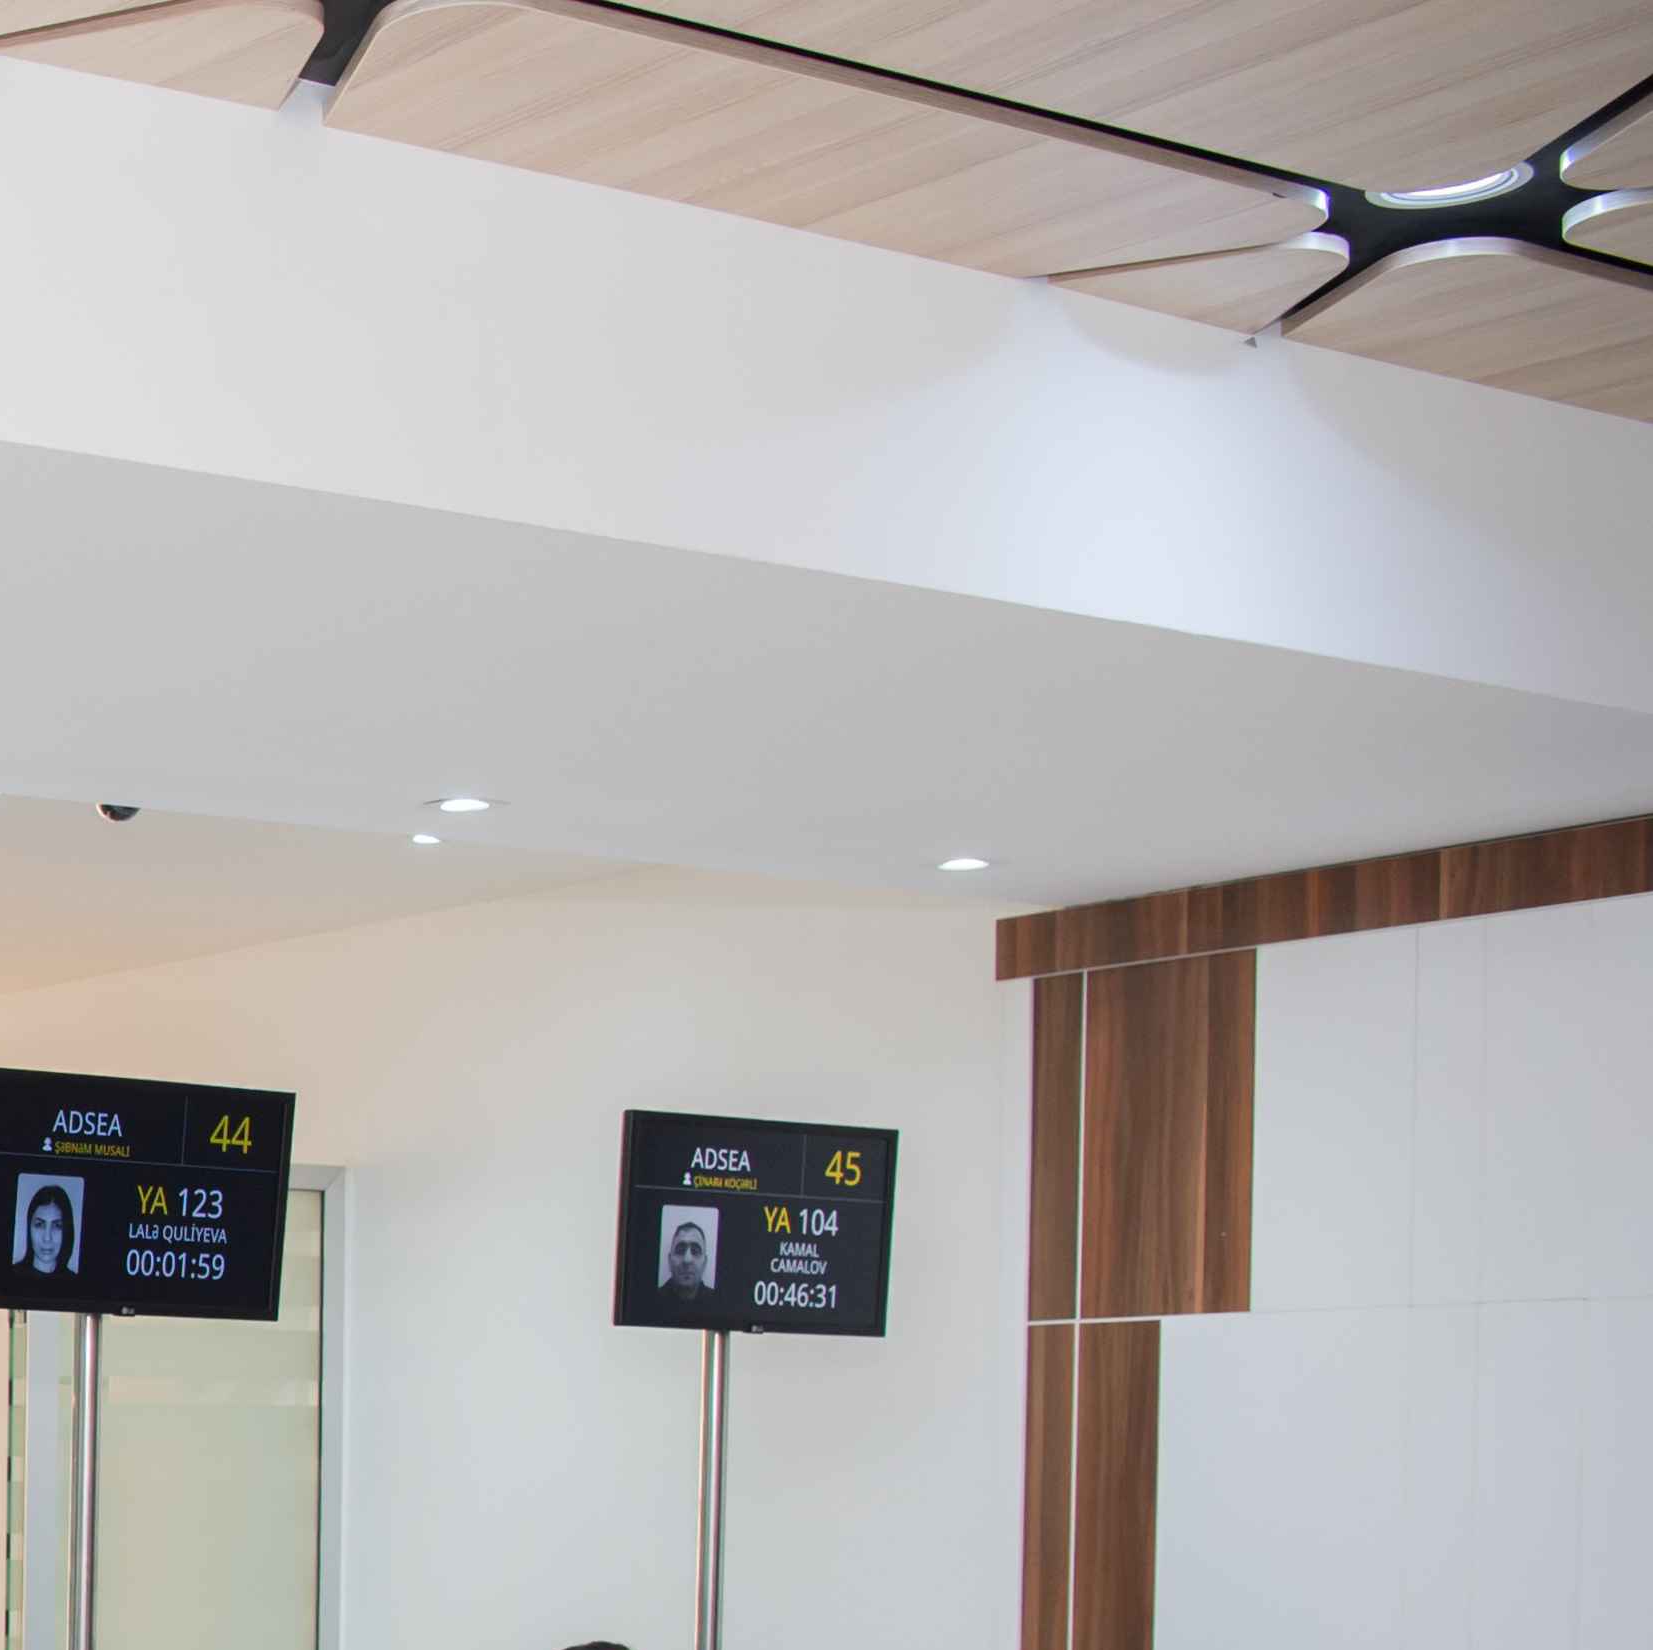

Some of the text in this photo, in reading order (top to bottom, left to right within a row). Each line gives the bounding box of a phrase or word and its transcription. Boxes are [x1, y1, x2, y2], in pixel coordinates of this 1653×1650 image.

[52, 1109, 123, 1137] ADSEA
[209, 1114, 252, 1154] 44
[690, 1147, 751, 1172] ADSEA
[824, 1150, 862, 1187] 45
[137, 1185, 223, 1219] YA 123
[162, 1223, 228, 1244] QULİYEVA
[764, 1206, 839, 1237] YA 104
[126, 1248, 225, 1281] 00:01:59
[779, 1242, 819, 1258] KAMAL
[769, 1257, 828, 1276] CAMALOV
[754, 1280, 837, 1309] 00:46:31
